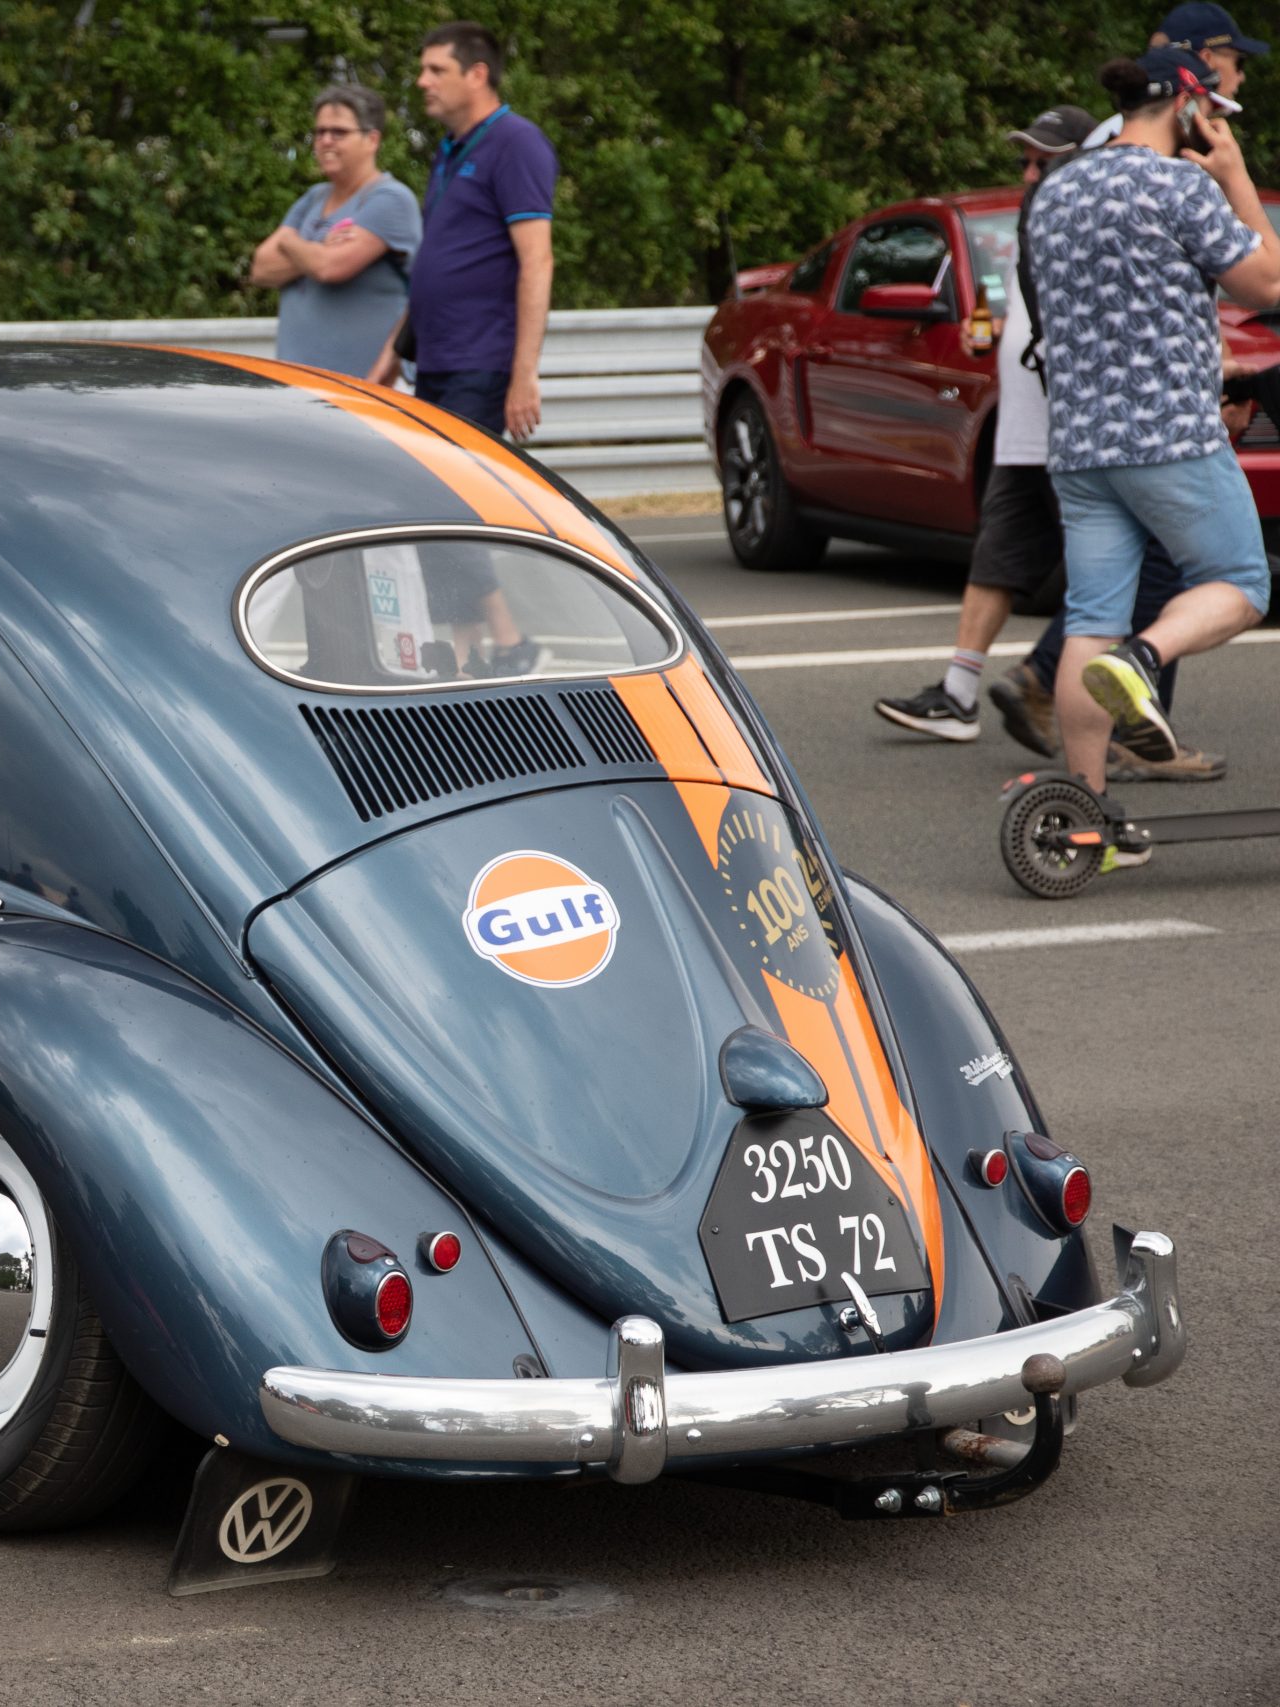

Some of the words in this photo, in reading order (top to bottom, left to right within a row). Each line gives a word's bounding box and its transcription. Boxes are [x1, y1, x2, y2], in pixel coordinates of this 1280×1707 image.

[477, 893, 605, 947] Gulf
[746, 865, 806, 946] 100
[786, 923, 810, 952] ANS
[743, 1134, 852, 1204] 3250
[745, 1222, 827, 1289] TS
[839, 1213, 897, 1275] 72
